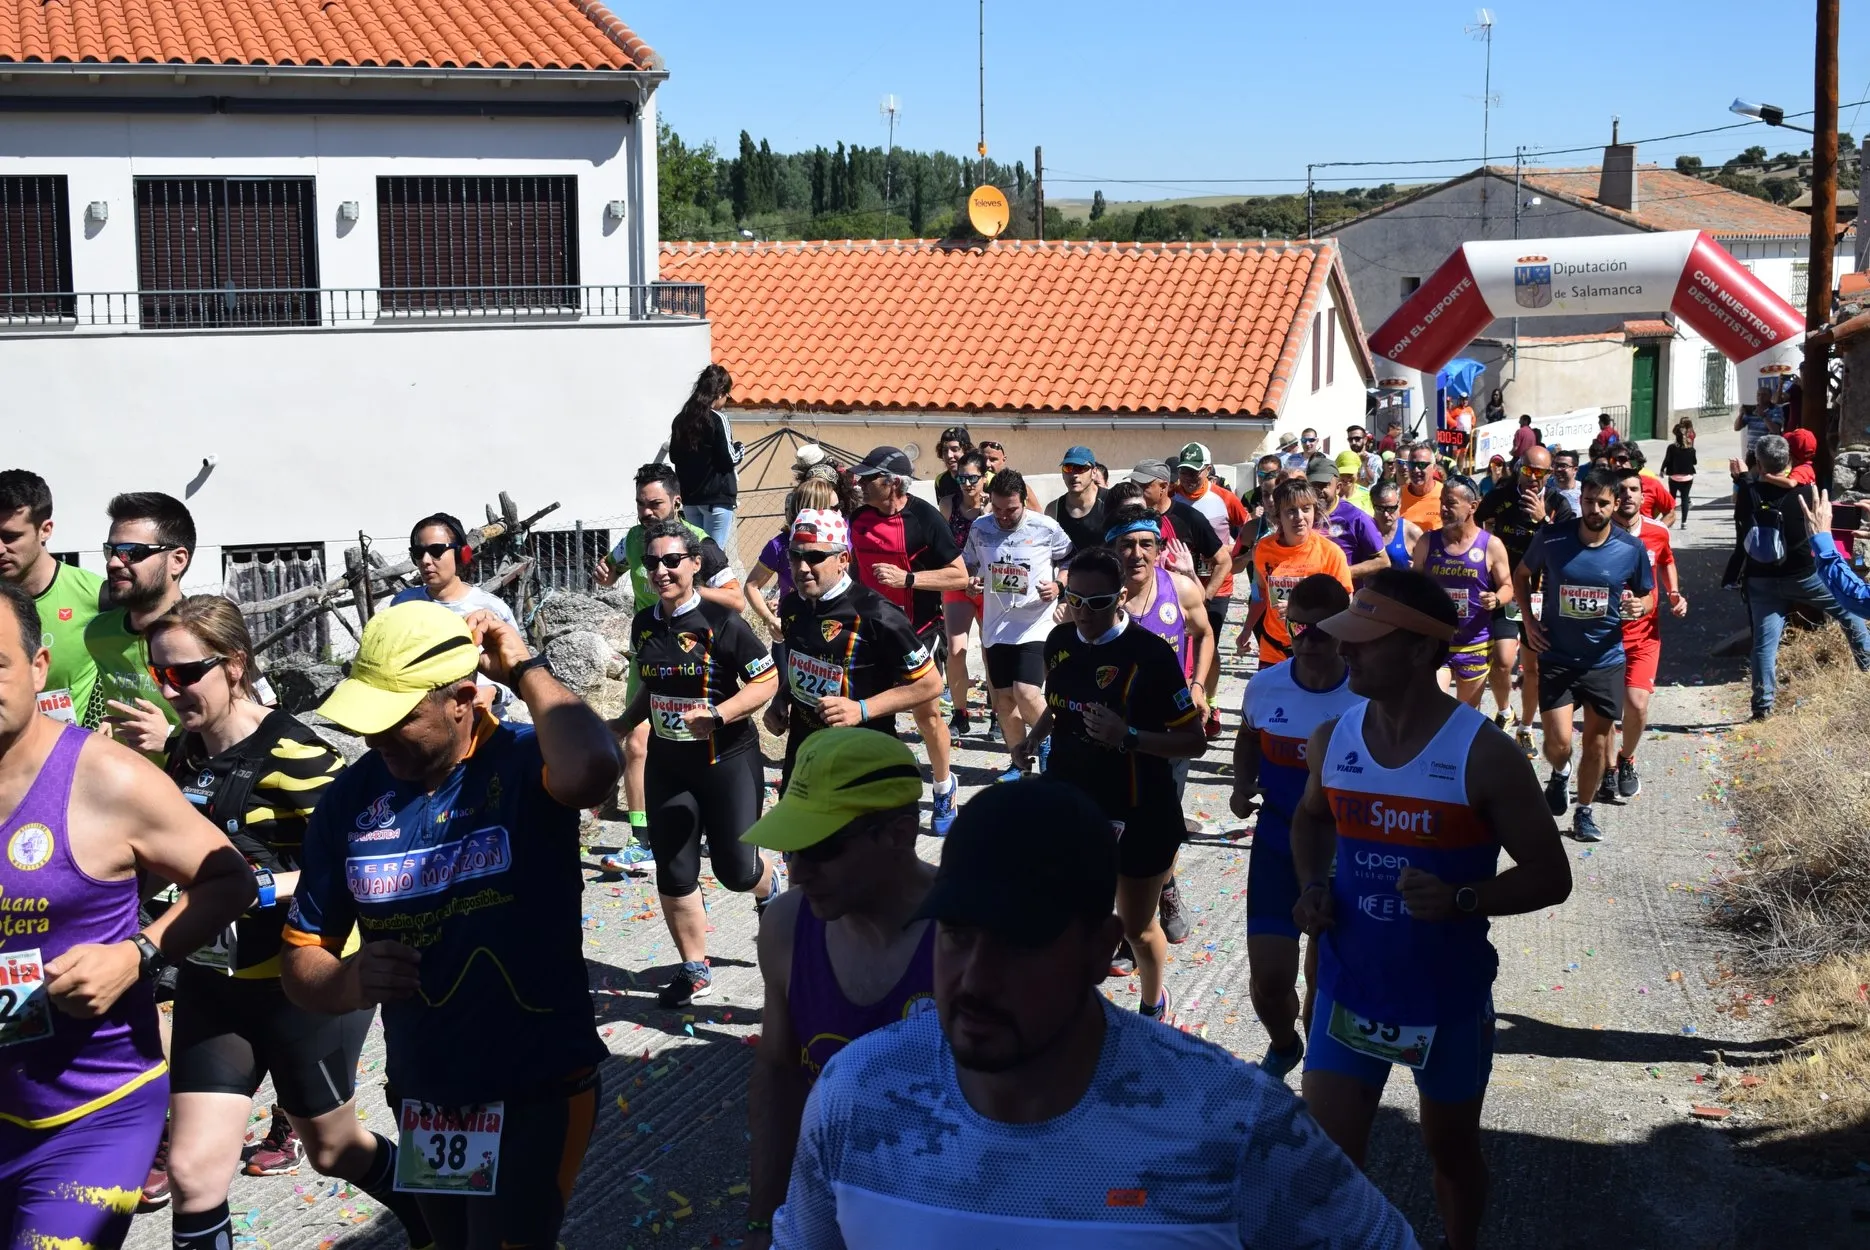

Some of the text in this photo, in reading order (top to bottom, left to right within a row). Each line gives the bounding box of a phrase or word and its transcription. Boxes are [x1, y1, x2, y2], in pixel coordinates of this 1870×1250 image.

[1553, 259, 1627, 276] Diputación
[1554, 285, 1643, 299] de Salamanca
[1693, 270, 1778, 340] CON NUESTROS
[1387, 277, 1473, 359] CON EL DEPORTE
[1687, 286, 1762, 347] DEPORTISTAS
[1002, 575, 1019, 587] 42
[1432, 564, 1478, 578] Macotera
[1570, 598, 1598, 611] 153
[641, 662, 703, 679] Malpartida
[796, 671, 828, 695] 224
[660, 712, 688, 730] 22
[1336, 764, 1363, 774] VIATOR
[349, 834, 499, 873] PERSIANAS
[350, 847, 502, 896] RUANO MONZON
[0, 889, 49, 911] uano
[0, 914, 49, 936] tera
[428, 1133, 468, 1171] 38
